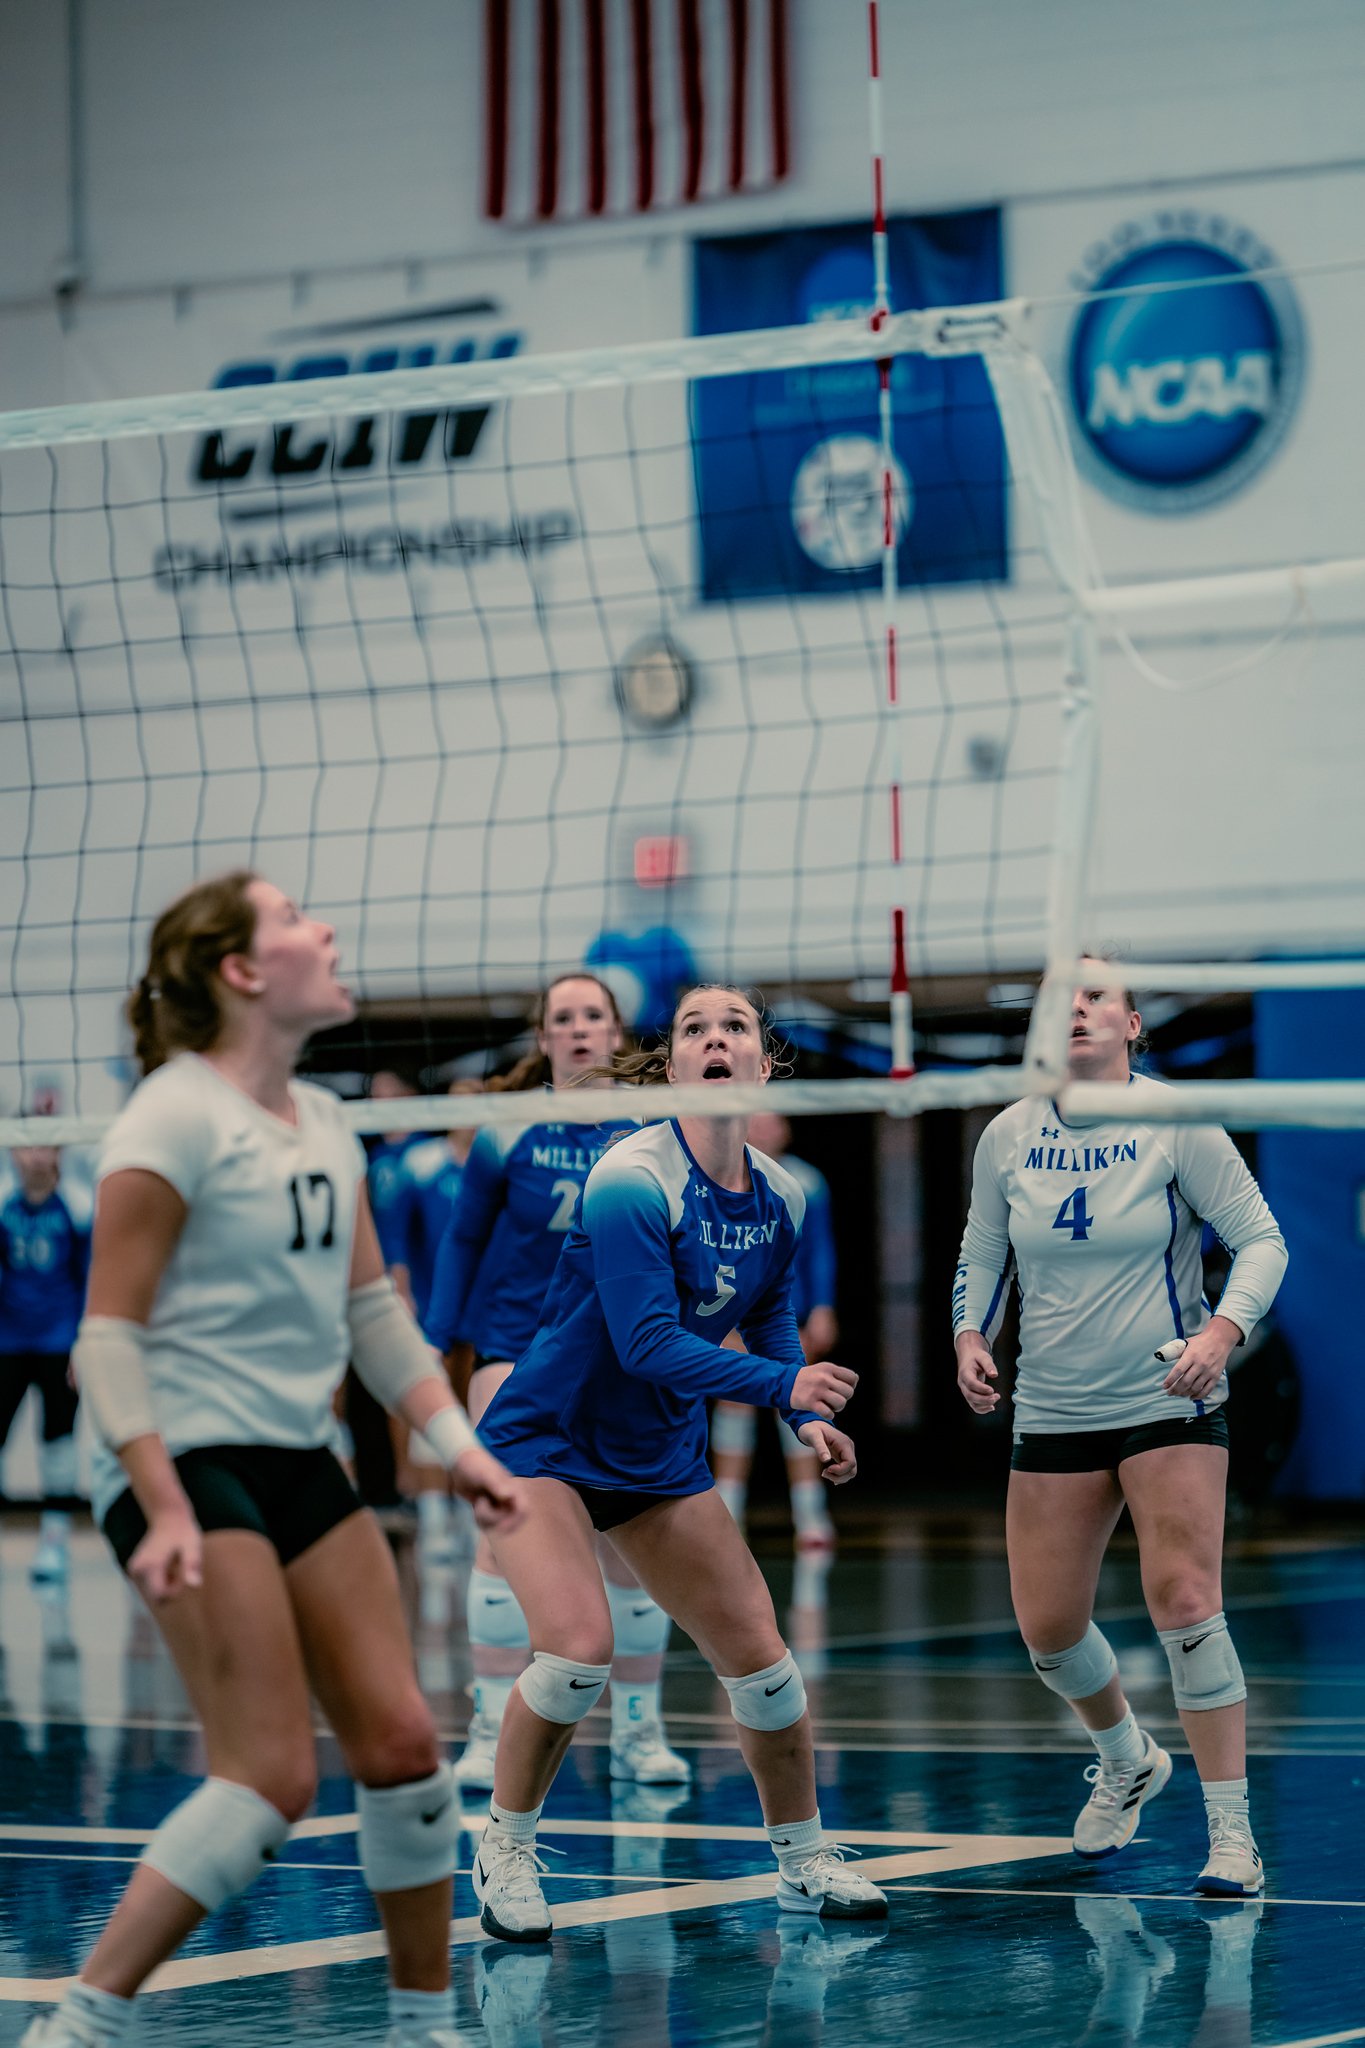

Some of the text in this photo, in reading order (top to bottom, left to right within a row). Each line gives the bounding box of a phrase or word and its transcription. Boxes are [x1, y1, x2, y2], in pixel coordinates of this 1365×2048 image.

[1087, 351, 1271, 429] NCAA
[153, 509, 576, 590] CHAMPIONSHIP
[531, 1144, 606, 1172] MILLI
[1023, 1139, 1137, 1172] MILLIKIN
[288, 1171, 335, 1251] 17
[1051, 1186, 1095, 1241] 4
[695, 1264, 737, 1317] 5
